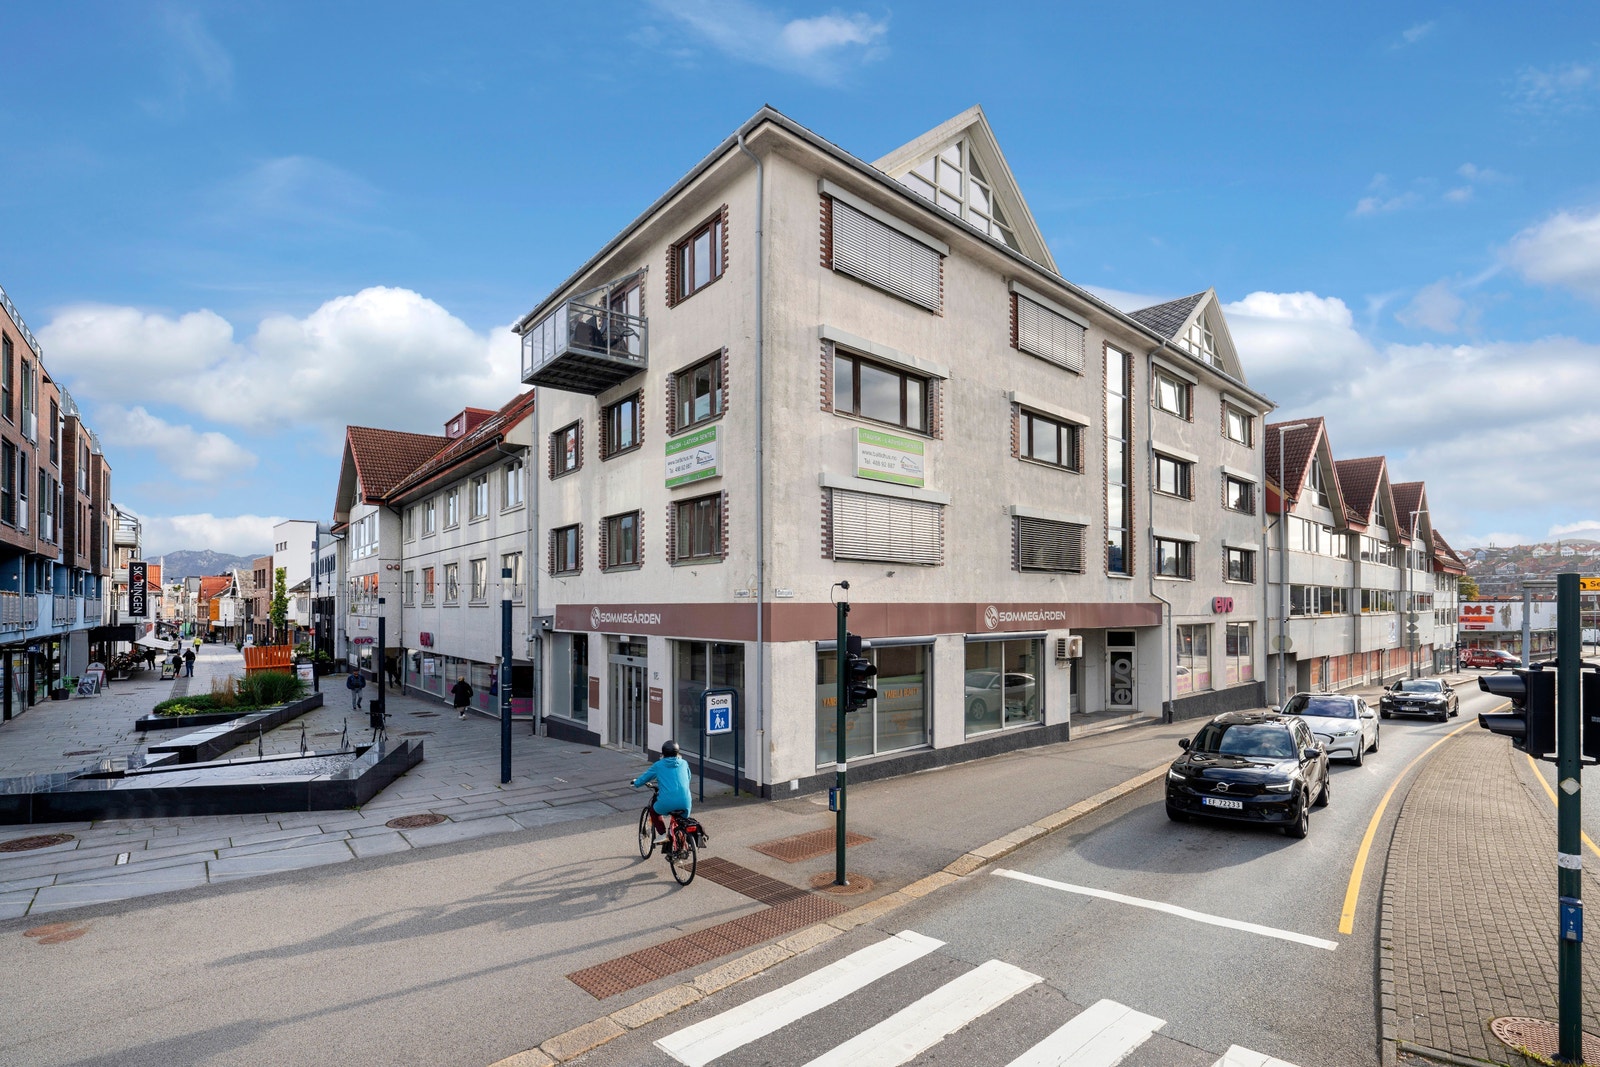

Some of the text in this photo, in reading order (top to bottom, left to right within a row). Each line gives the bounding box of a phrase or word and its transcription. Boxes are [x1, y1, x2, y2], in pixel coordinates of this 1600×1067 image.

[133, 566, 143, 614] SKORINGEN
[1215, 596, 1234, 613] evo
[600, 610, 661, 625] SØMMEGÅRDEN
[999, 608, 1066, 622] SØMMEGÅRDEN
[354, 637, 374, 645] evo
[1114, 658, 1132, 705] evo
[711, 697, 728, 706] Sone
